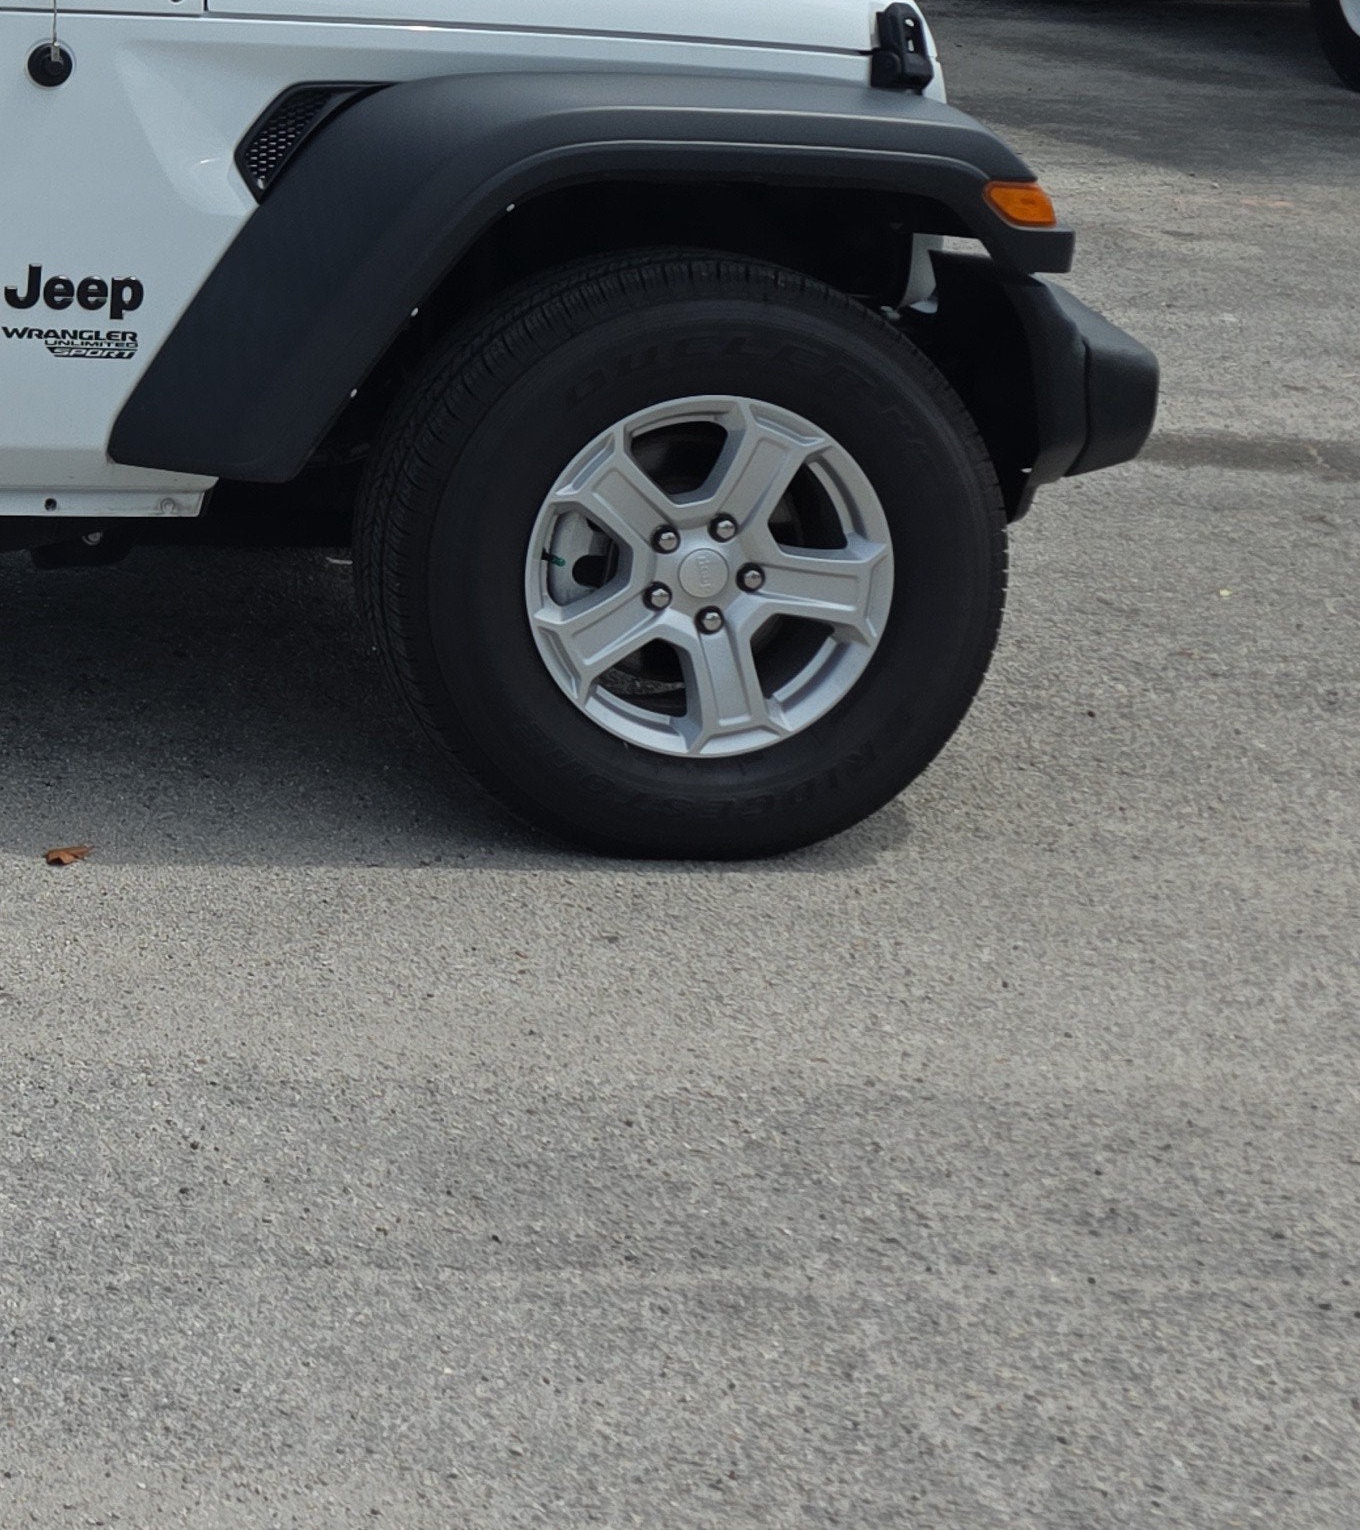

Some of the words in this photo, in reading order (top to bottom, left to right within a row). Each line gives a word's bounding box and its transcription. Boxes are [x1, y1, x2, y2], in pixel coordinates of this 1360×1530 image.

[3, 263, 144, 320] Jeep
[1, 326, 139, 342] WRANGLER
[44, 340, 139, 348] UNLIMITED
[51, 348, 136, 358] SPORT
